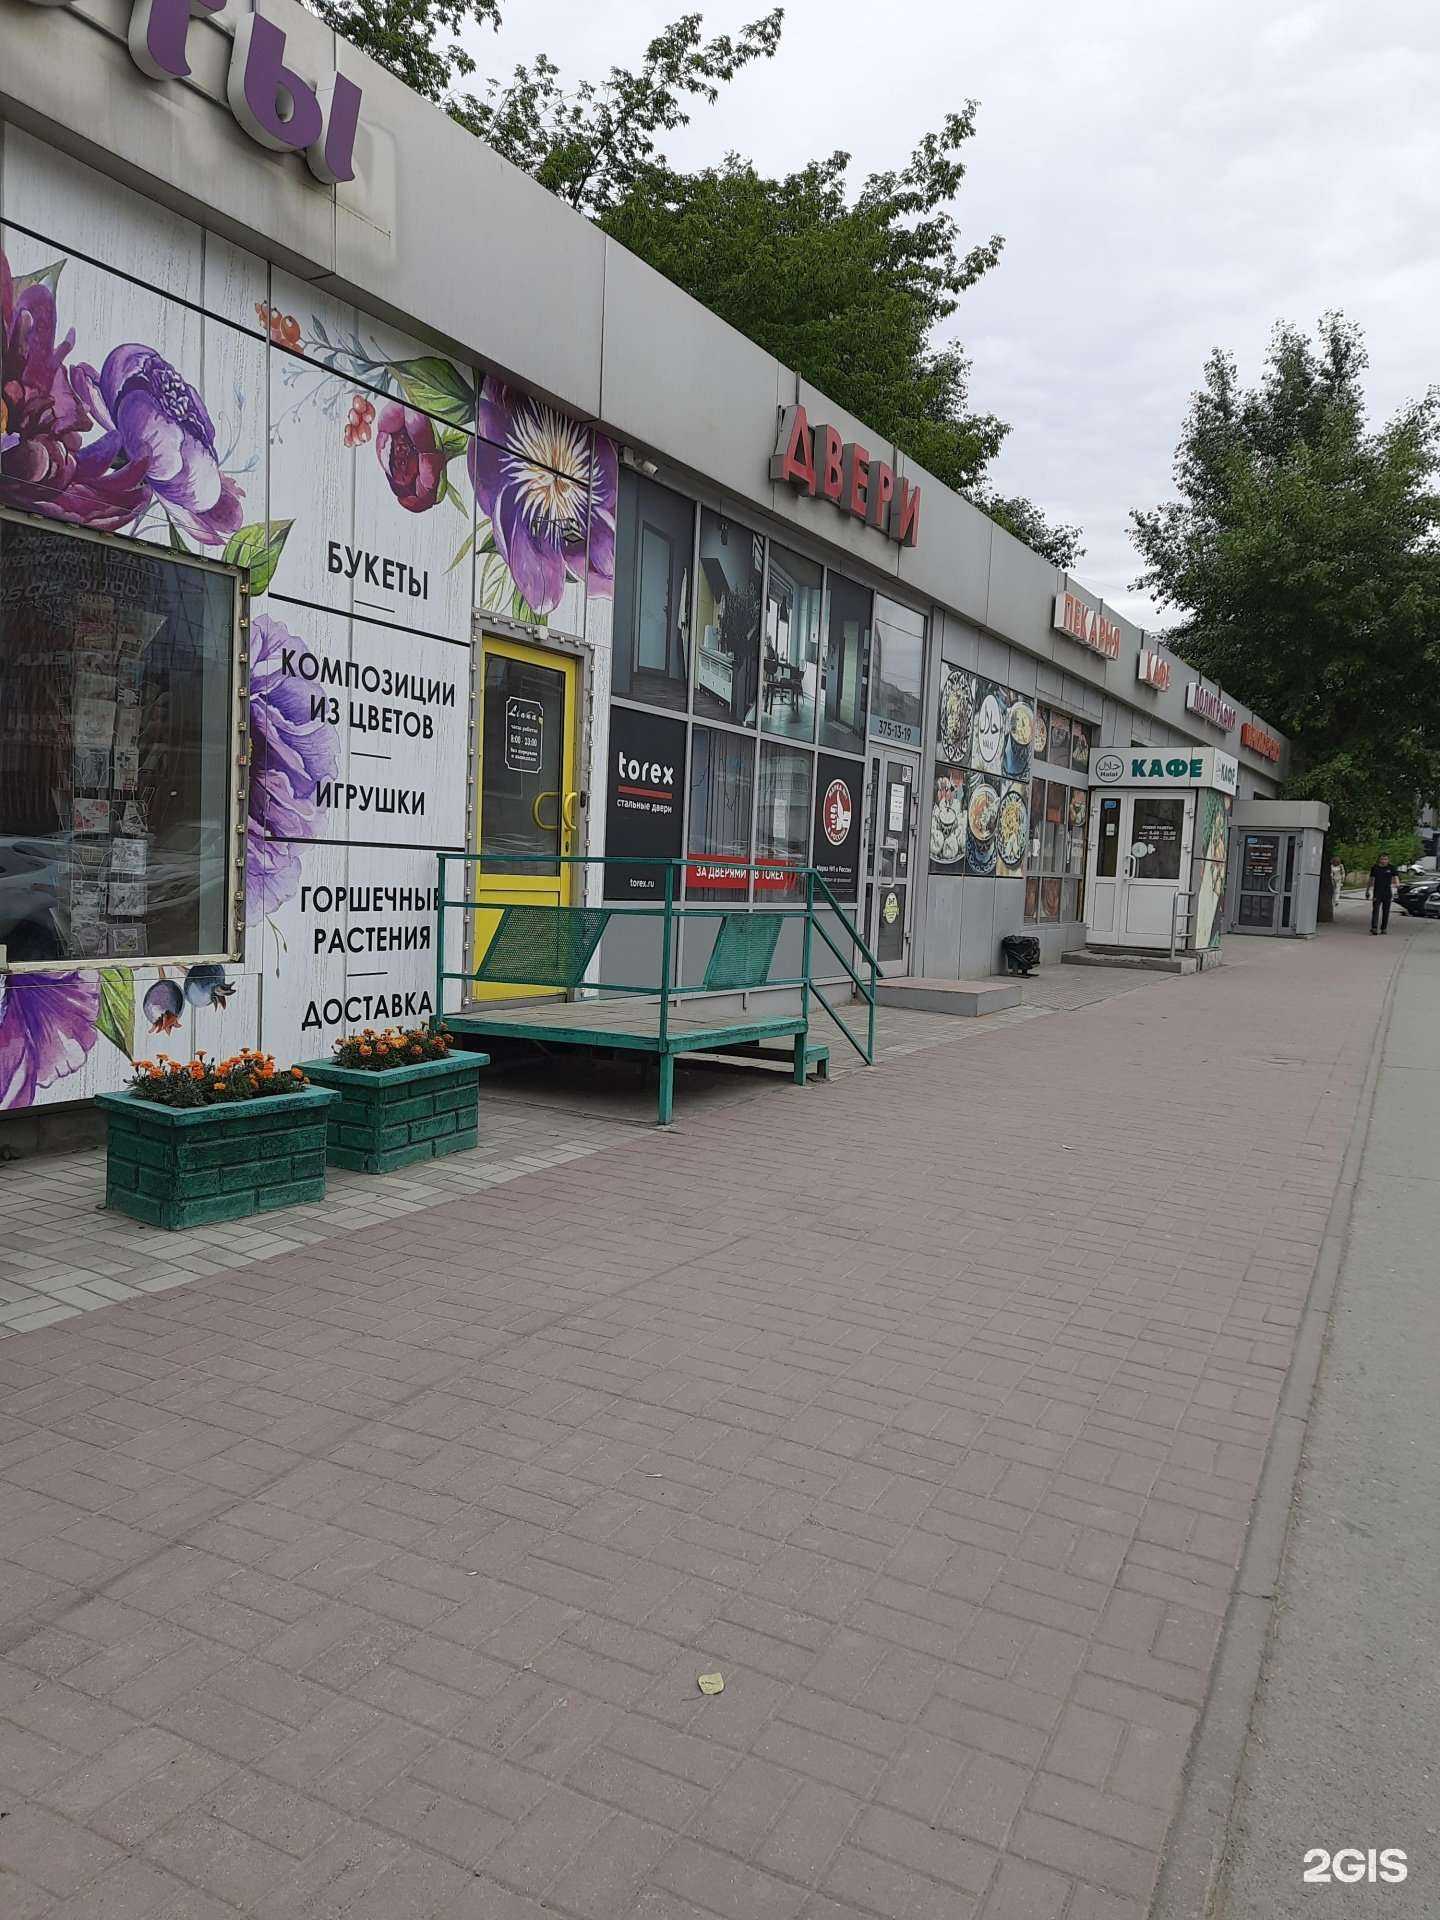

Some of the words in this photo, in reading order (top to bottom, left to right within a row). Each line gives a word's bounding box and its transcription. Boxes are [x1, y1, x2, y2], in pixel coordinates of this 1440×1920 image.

[775, 404, 921, 547] ДВЕРИ
[328, 540, 429, 600] БУКЕТЫ
[1060, 592, 1121, 660] ПЕКАРНЯ
[281, 648, 456, 707] КОМПОЗИЦИИ
[310, 694, 340, 725] ИЗ
[350, 701, 434, 739] ЦВЕТОВ
[879, 719, 912, 741] 375-13-19
[618, 751, 674, 785] torex
[1131, 758, 1204, 778] КАФЕ
[1220, 762, 1236, 786] КАФЕ
[316, 780, 426, 816] ИГРУШКИ
[616, 799, 650, 811] стальные
[651, 803, 673, 814] двери
[629, 878, 655, 888] torex.ru
[696, 865, 707, 877] ЗА
[708, 866, 747, 880] ДВЕРЯМИ
[314, 925, 431, 954] РАСТЕНИЯ
[301, 990, 433, 1031] ДОСТАВКА
